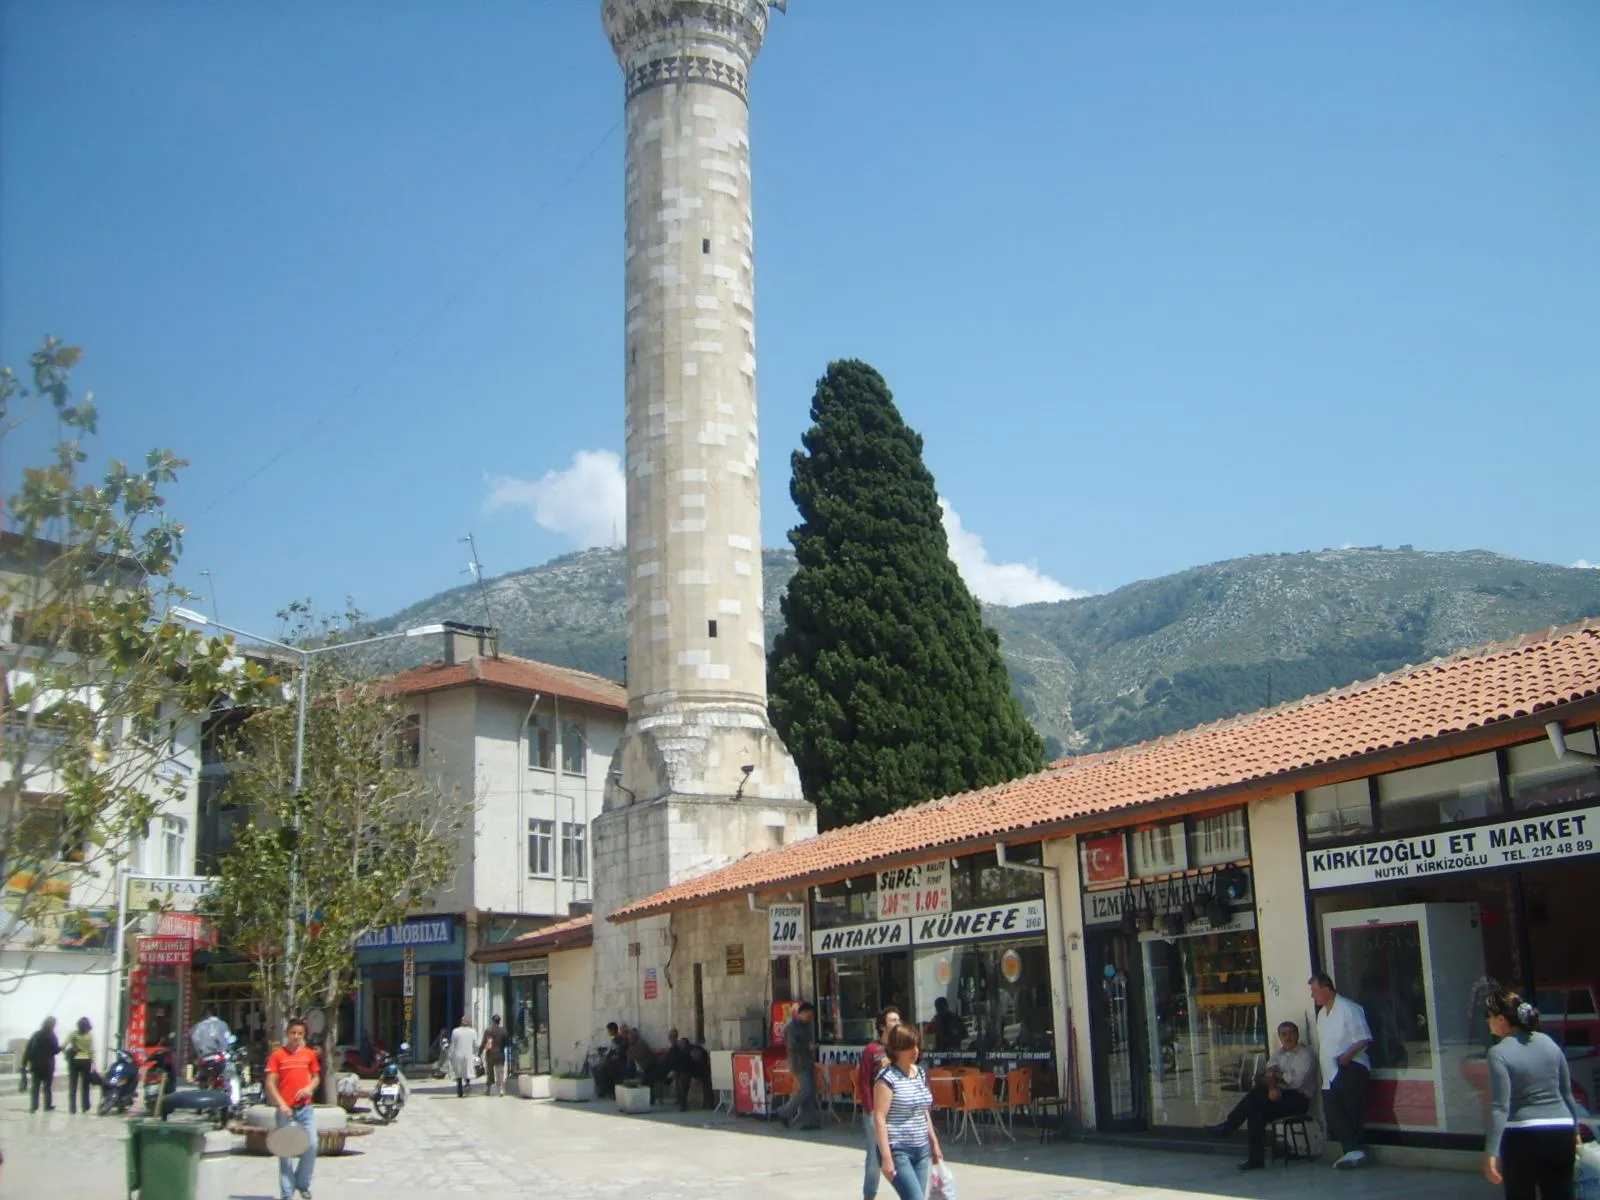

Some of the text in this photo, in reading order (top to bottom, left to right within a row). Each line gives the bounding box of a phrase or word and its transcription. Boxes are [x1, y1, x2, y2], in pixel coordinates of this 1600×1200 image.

[1448, 832, 1477, 854] ET
[1489, 815, 1587, 848] MARKET
[1374, 864, 1409, 879] NUTKİ
[1532, 845, 1553, 858] 212
[1557, 842, 1573, 854] 48
[1576, 840, 1593, 852] 89
[390, 921, 449, 945] MOBİLYA
[773, 921, 797, 942] 2.00
[821, 924, 902, 951] ANTAKYA
[919, 908, 1020, 940] KÜNEFE
